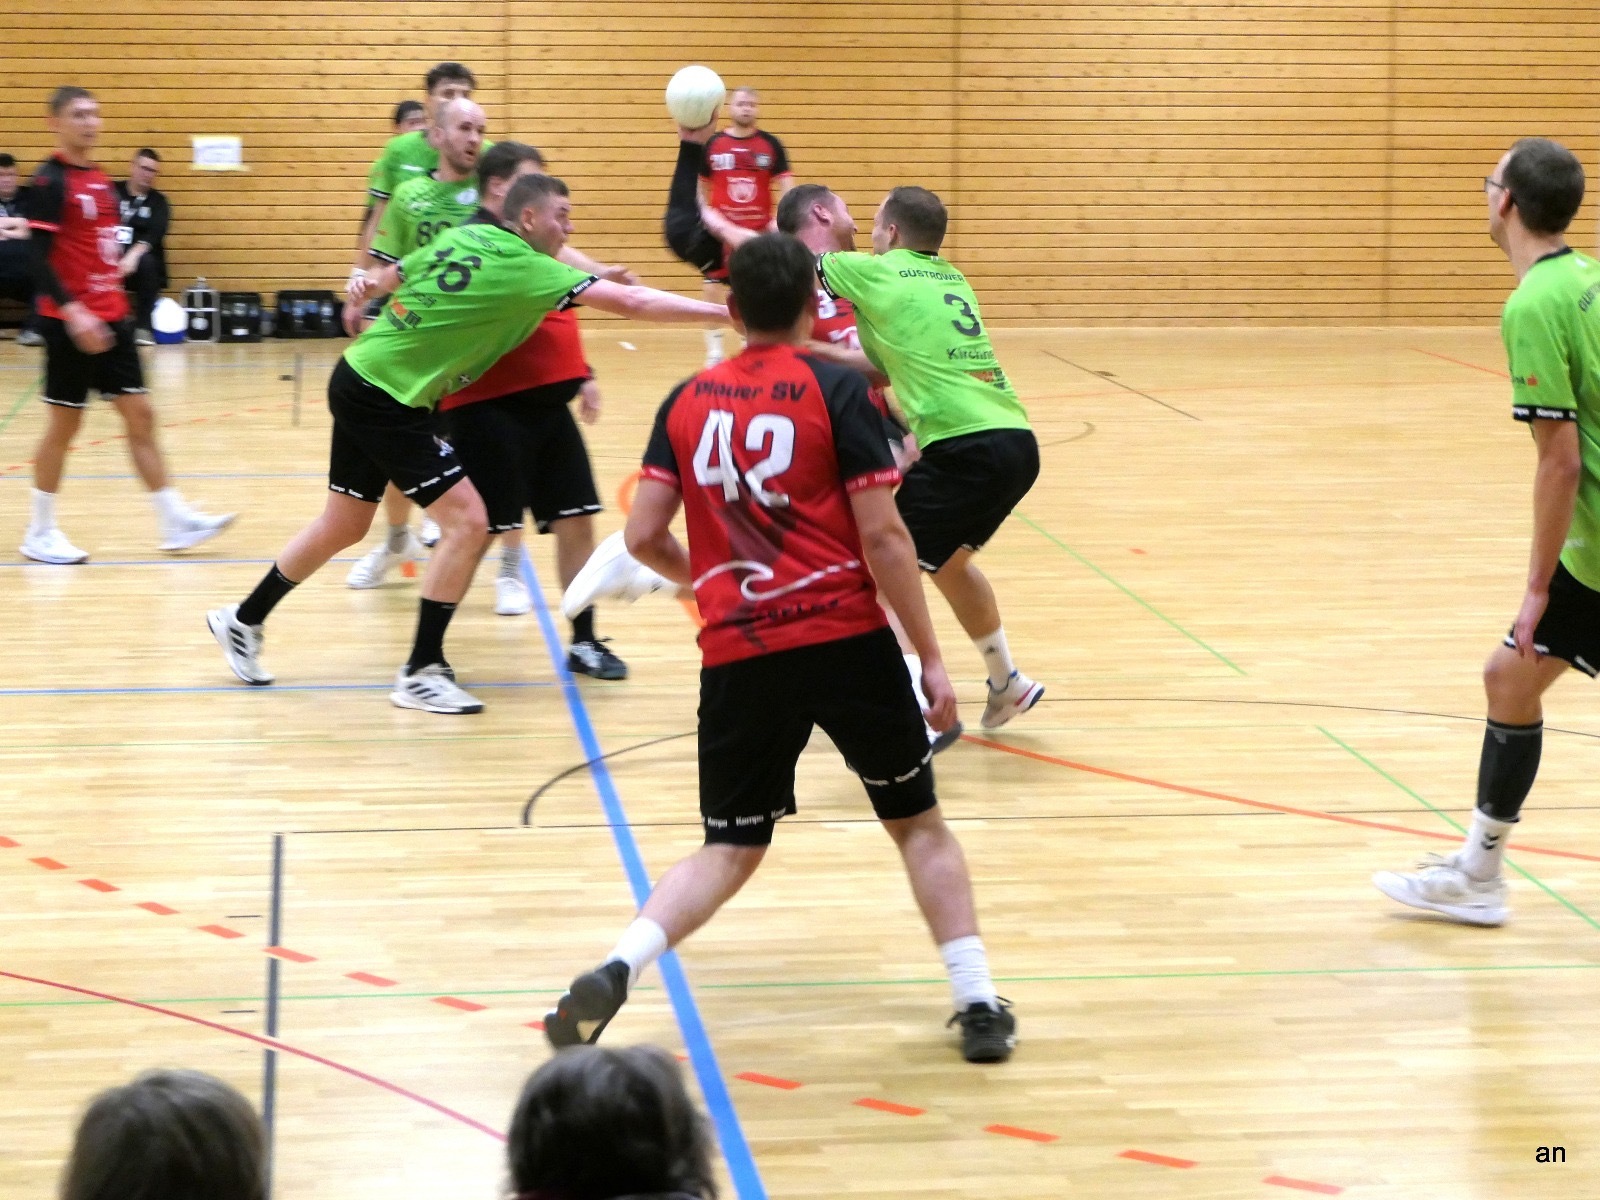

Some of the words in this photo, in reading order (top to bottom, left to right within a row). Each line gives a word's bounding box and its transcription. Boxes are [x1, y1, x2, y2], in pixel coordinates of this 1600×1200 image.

[422, 247, 482, 293] 16
[898, 267, 965, 282] GÜSTROWER
[943, 293, 981, 337] 3
[770, 381, 807, 401] SV
[692, 408, 796, 507] 42
[735, 814, 765, 827] Kempa
